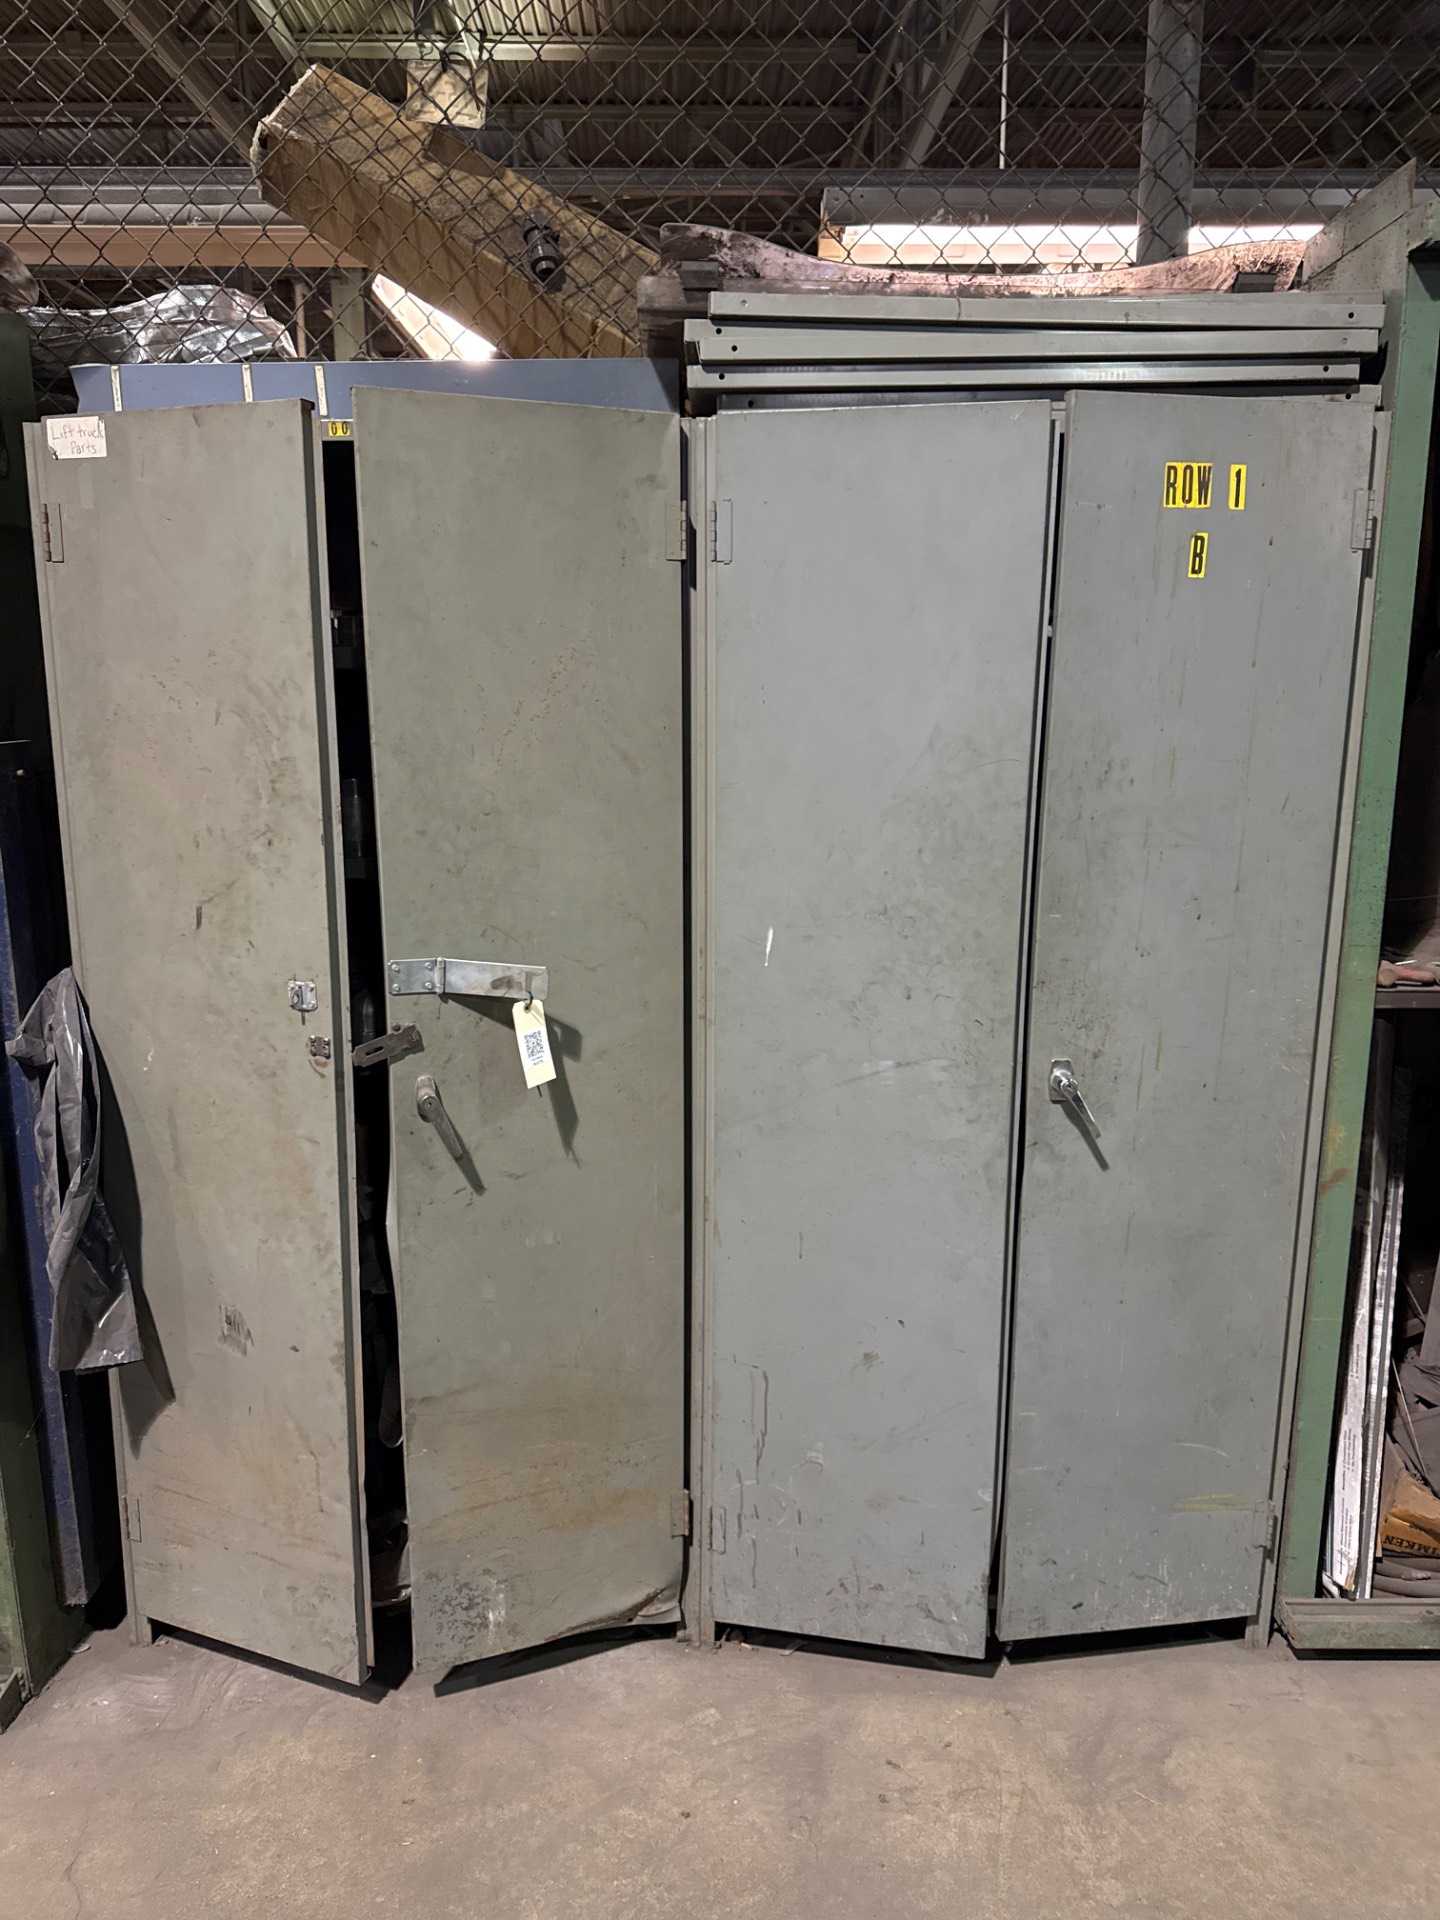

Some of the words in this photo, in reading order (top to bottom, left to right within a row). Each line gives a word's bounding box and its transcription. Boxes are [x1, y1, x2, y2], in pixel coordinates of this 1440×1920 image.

[51, 422, 73, 440] Lift
[78, 421, 105, 439] truck
[70, 440, 97, 455] Parts
[1165, 464, 1212, 505] ROW
[1235, 468, 1242, 508] 1
[1191, 535, 1206, 575] B
